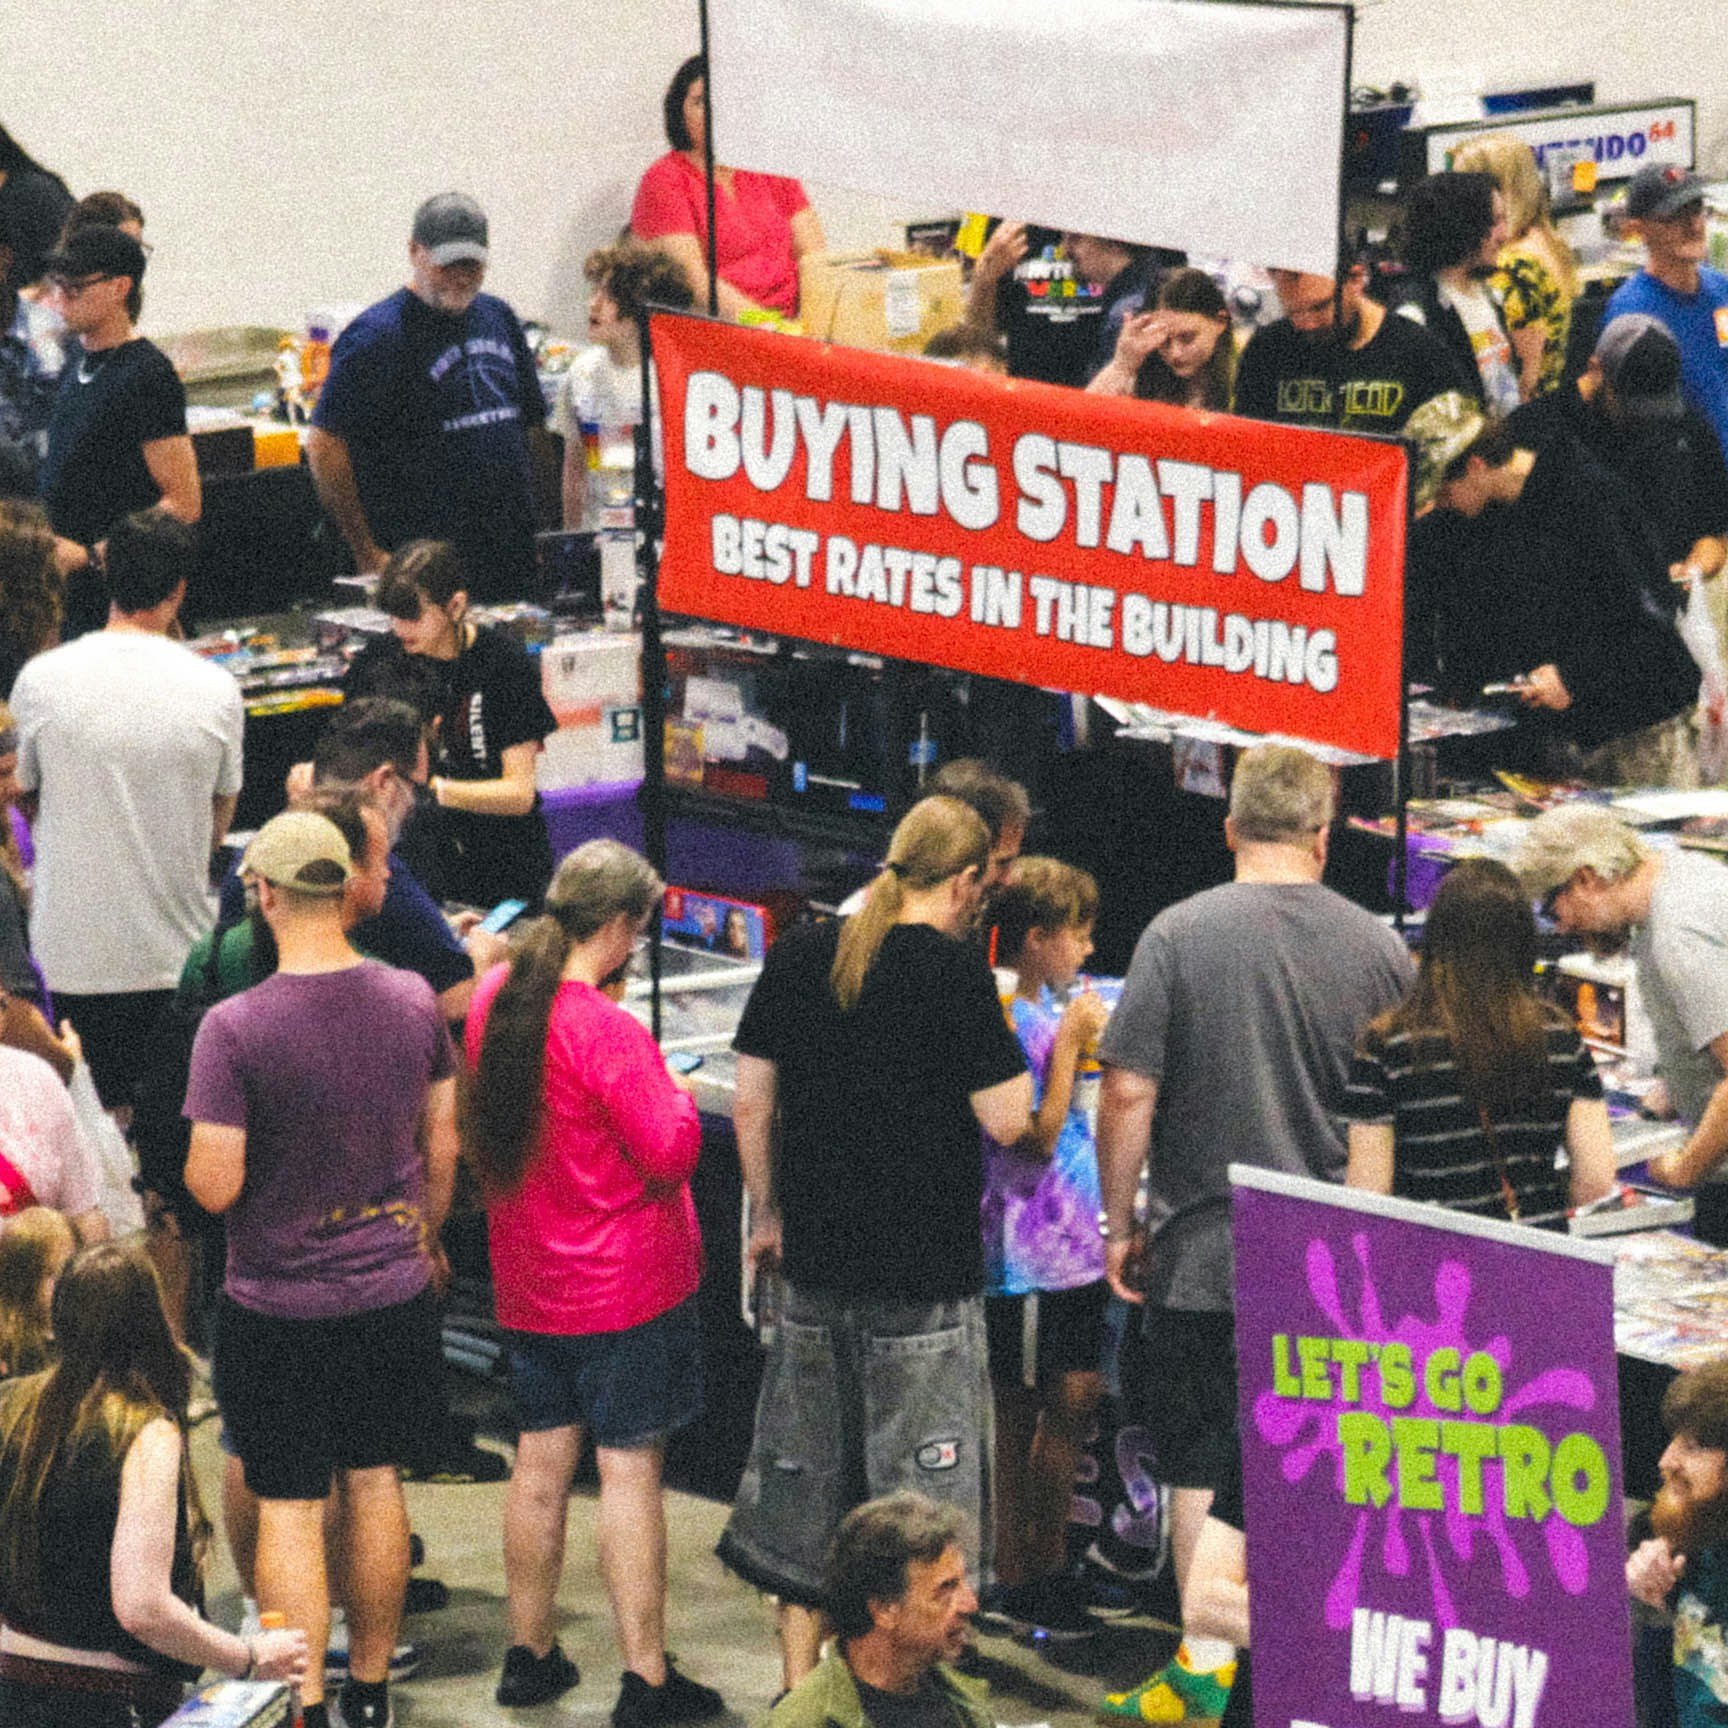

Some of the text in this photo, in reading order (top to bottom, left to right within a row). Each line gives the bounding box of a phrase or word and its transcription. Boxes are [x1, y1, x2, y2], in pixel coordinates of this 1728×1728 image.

[1649, 120, 1677, 143] 64
[684, 370, 1369, 596] BUYING STATION
[711, 515, 1339, 693] BEST RATES IN THE BUILDING
[1271, 1333, 1504, 1413] LET'S GO
[1338, 1411, 1611, 1526] RETRO
[1349, 1607, 1433, 1712] WE
